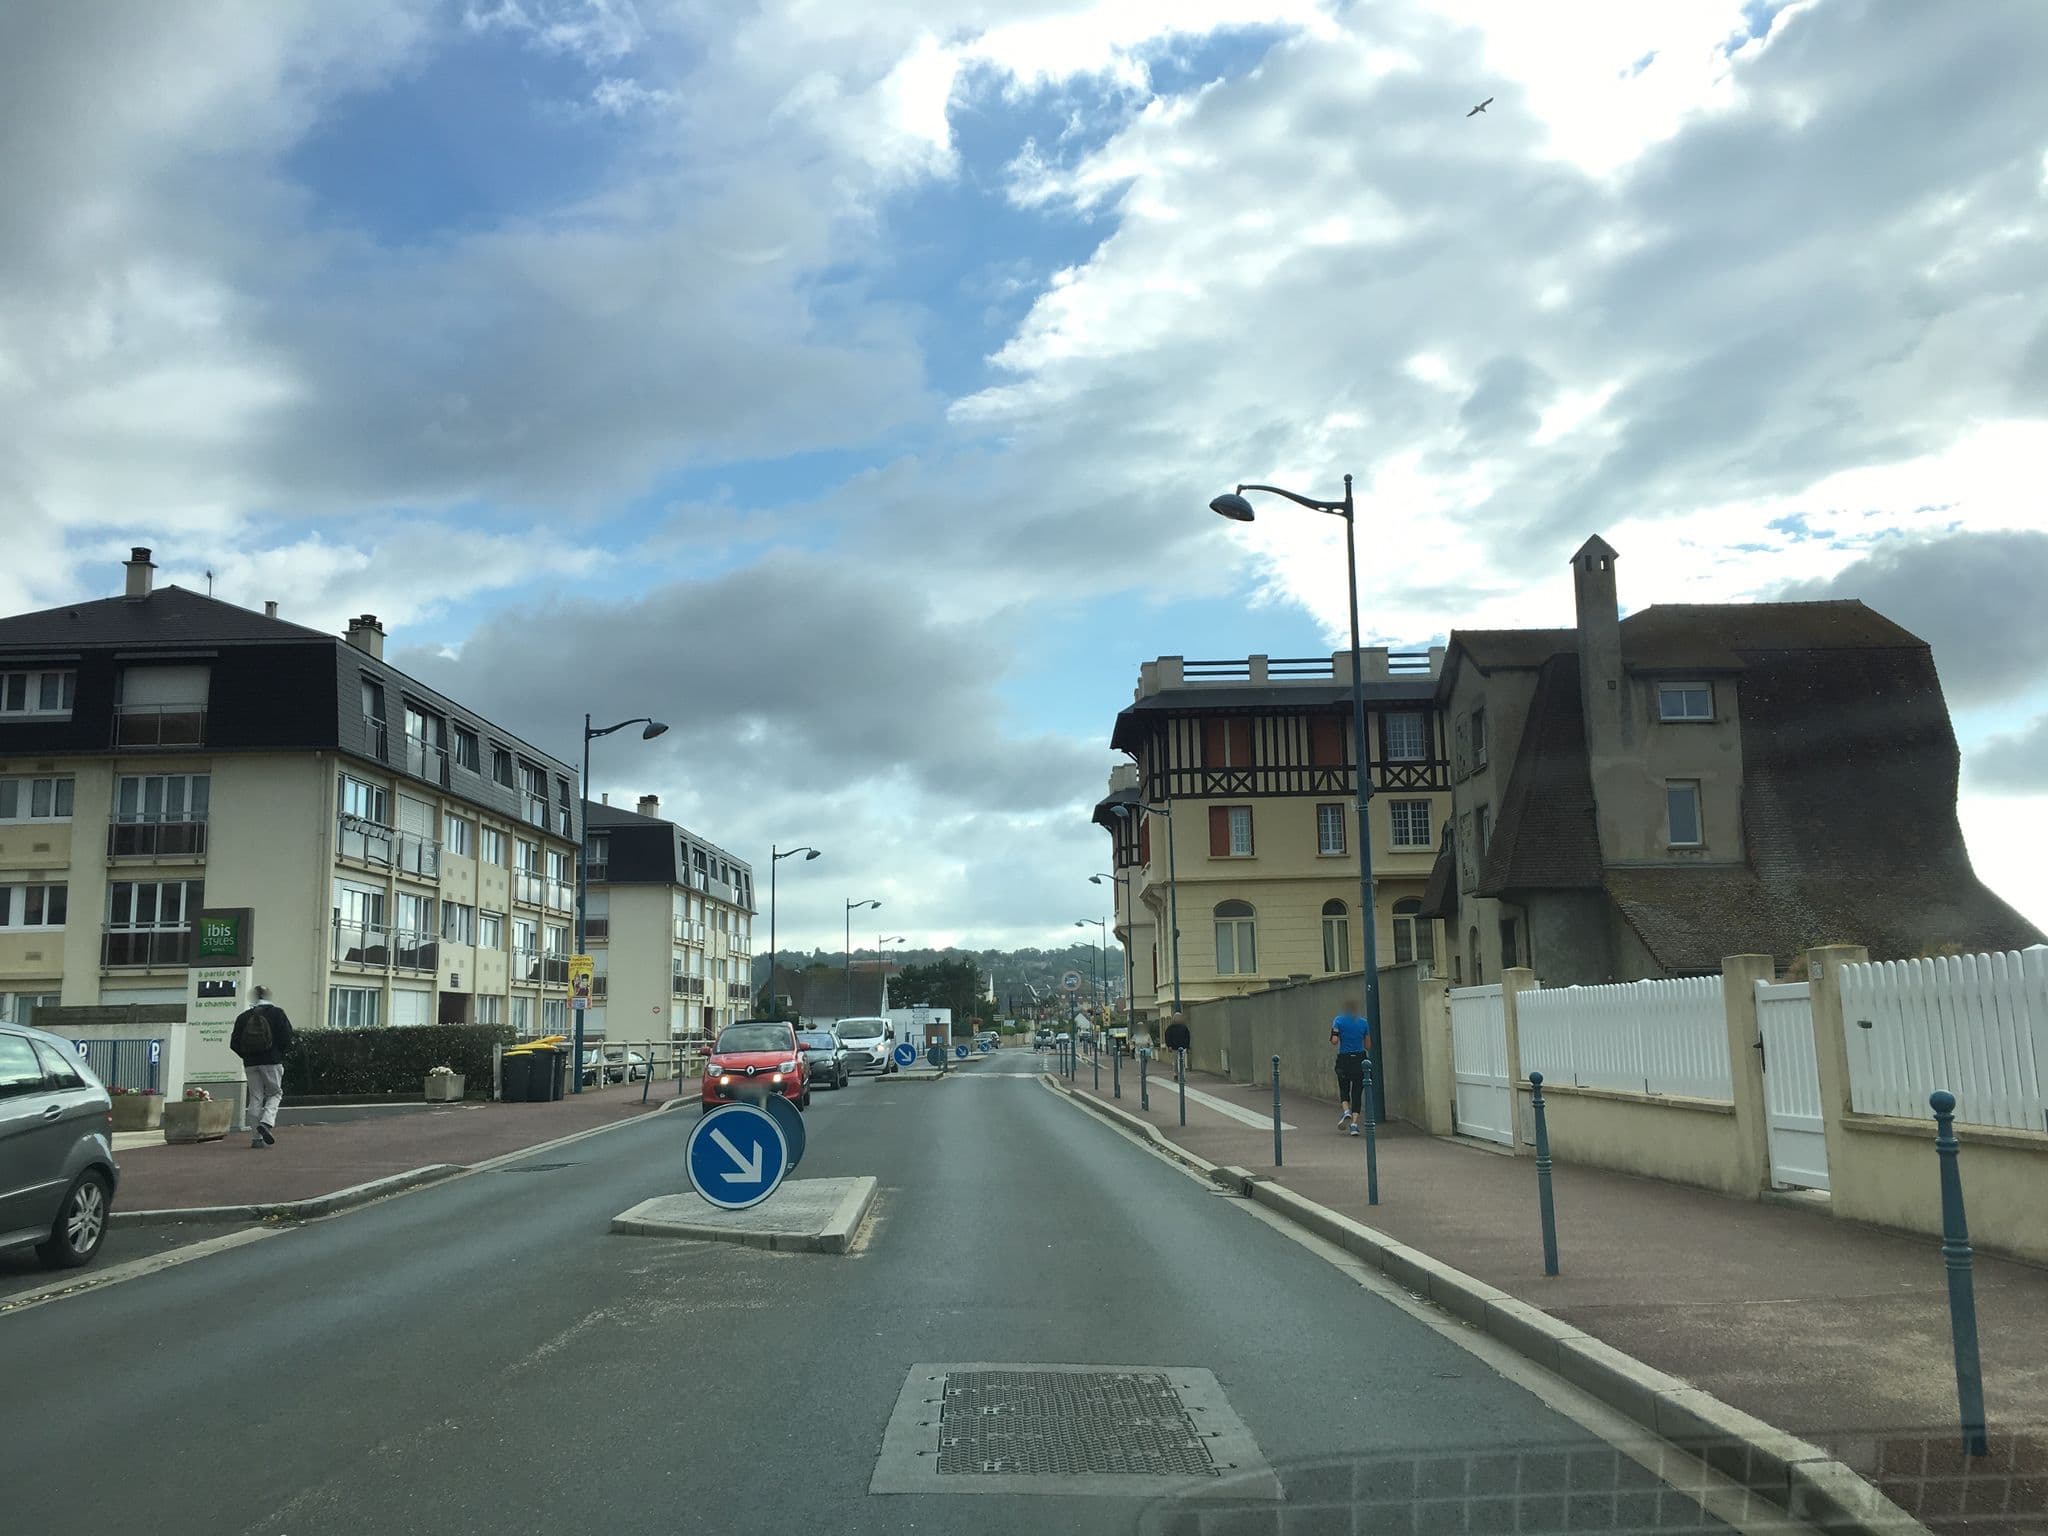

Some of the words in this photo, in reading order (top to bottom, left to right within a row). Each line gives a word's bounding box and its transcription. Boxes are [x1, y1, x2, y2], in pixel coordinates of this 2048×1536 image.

[207, 924, 231, 937] ibis
[204, 970, 226, 978] partir
[151, 1042, 160, 1056] P
